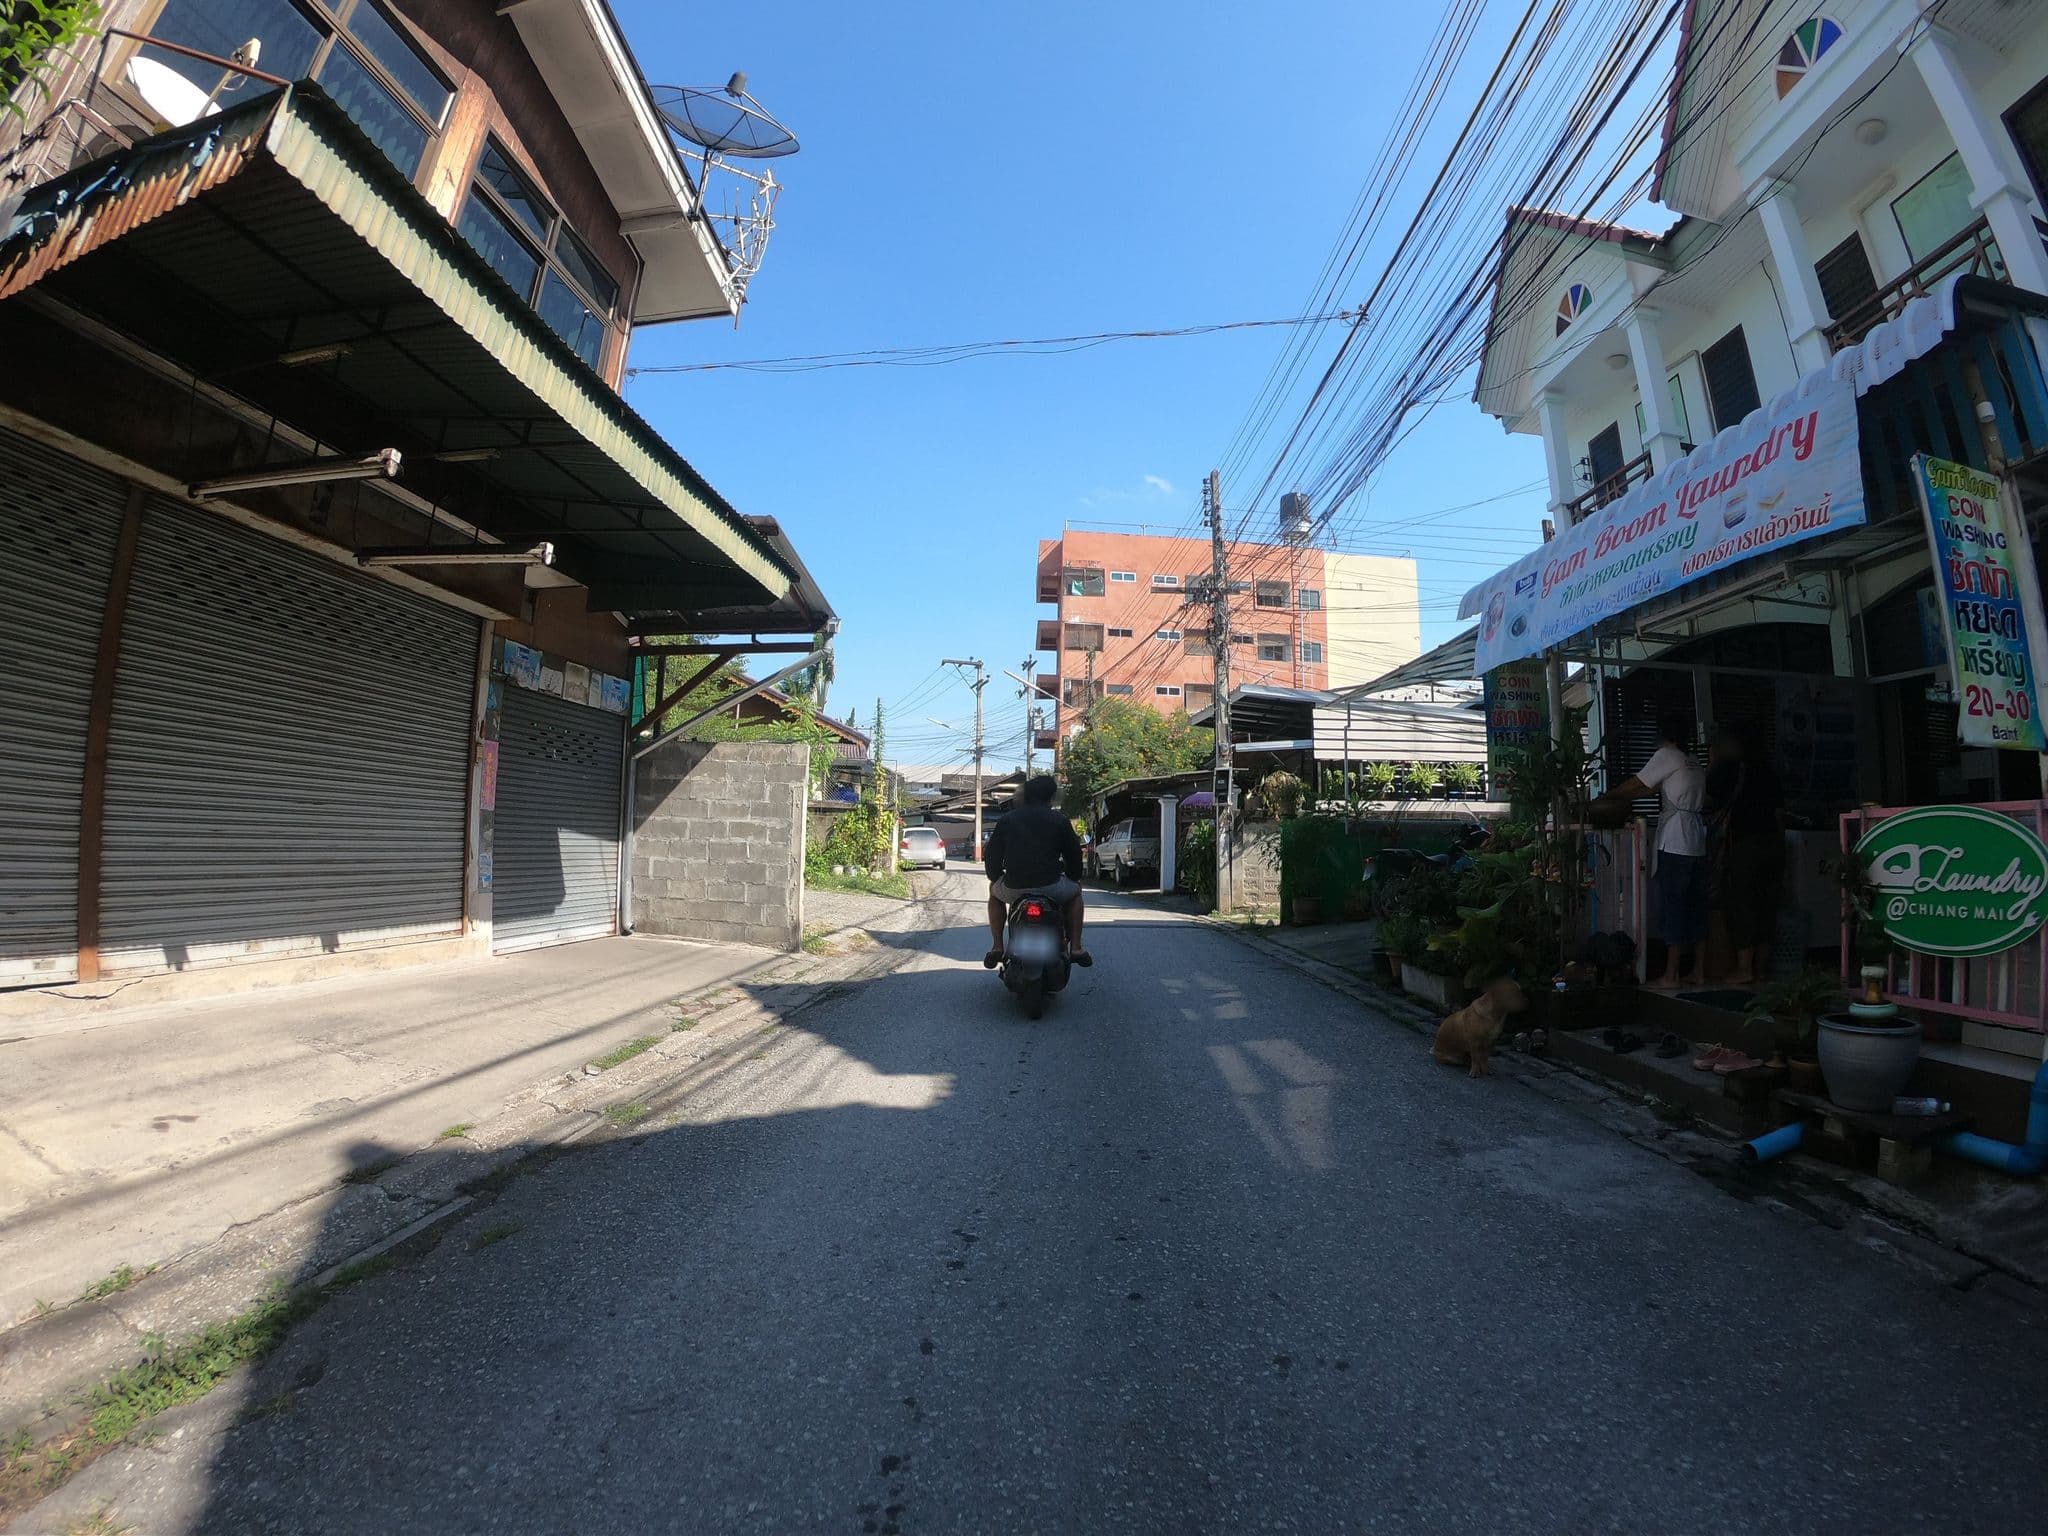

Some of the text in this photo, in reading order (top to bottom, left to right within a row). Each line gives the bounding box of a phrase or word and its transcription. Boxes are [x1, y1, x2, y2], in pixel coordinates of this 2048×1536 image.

[1541, 547, 1588, 599] Gam
[1594, 502, 1667, 561] Boom
[1676, 411, 1819, 519] Laundry
[1948, 495, 1986, 525] COIN
[1941, 519, 2008, 550] WASHING
[1947, 546, 2013, 601] ซักผ้า
[1954, 599, 2018, 641] หยอด
[1960, 638, 2026, 688] เหรียญ
[1491, 691, 1541, 702] WASHING
[1498, 676, 1531, 689] COIN
[1966, 684, 2030, 721] 20-30
[1992, 725, 2019, 742] Baht
[1914, 845, 2042, 921] Laundry
[1973, 906, 2004, 921] MAI
